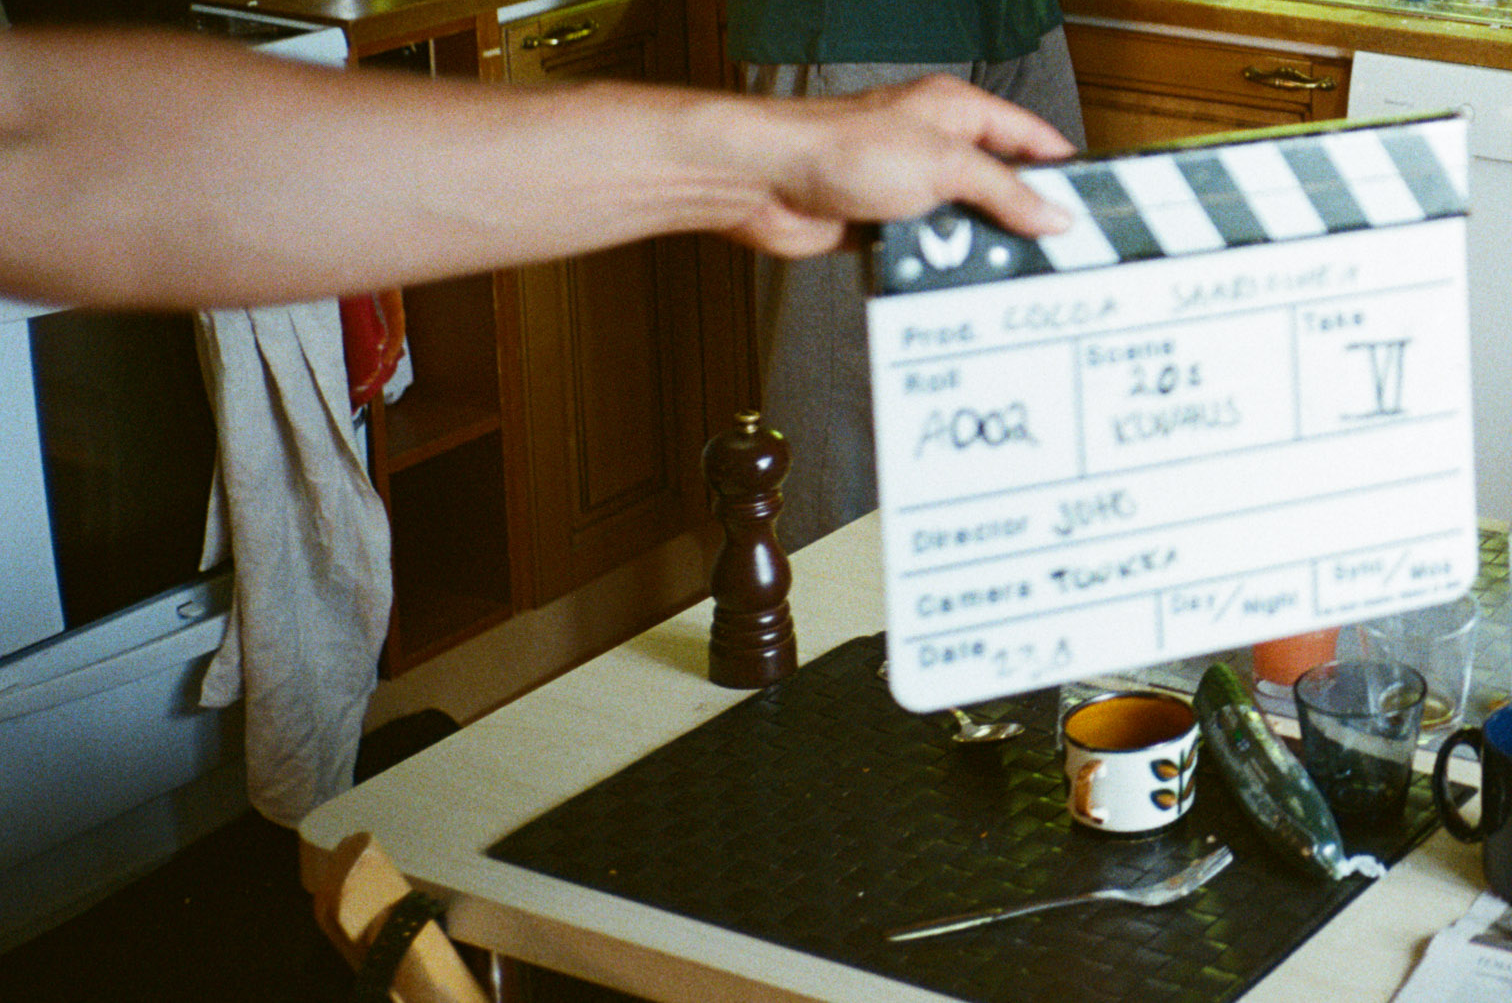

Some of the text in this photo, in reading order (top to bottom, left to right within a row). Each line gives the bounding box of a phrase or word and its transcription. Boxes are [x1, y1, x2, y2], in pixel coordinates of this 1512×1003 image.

[1303, 309, 1366, 333] Take
[1086, 338, 1176, 366] Scene
[911, 514, 1029, 553] Director
[915, 580, 1032, 618] Camera
[918, 637, 986, 668] Date
